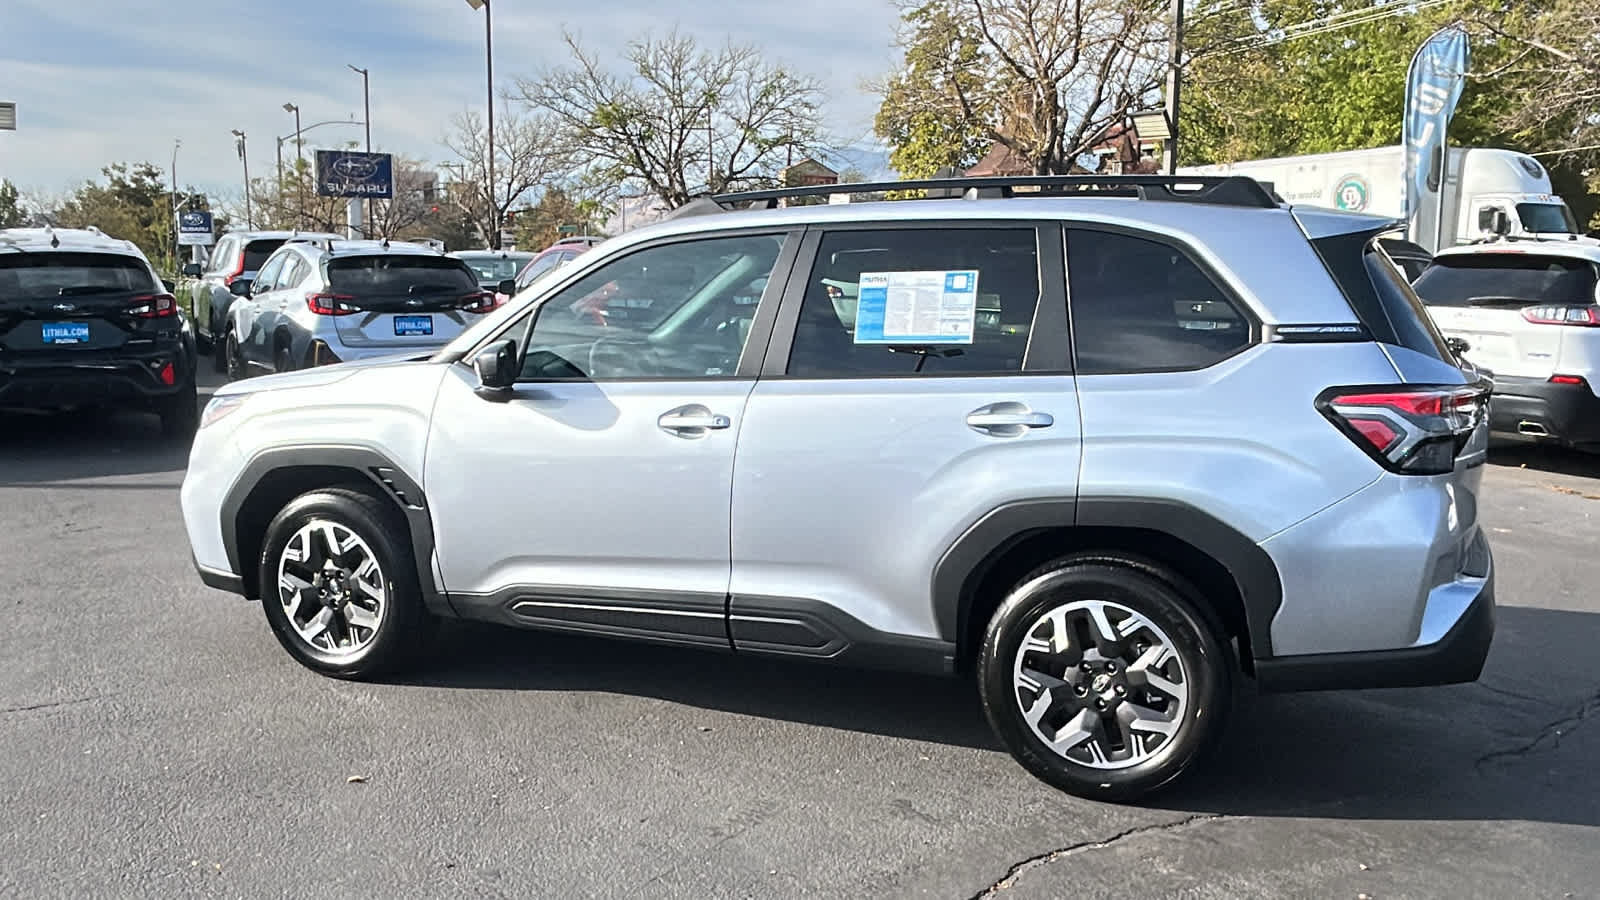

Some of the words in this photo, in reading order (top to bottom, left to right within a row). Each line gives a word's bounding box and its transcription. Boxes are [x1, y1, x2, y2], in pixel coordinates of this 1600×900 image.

[327, 182, 387, 193] SUBARU
[396, 321, 431, 329] LITHIA.COM
[42, 327, 89, 337] LITHIA.COM
